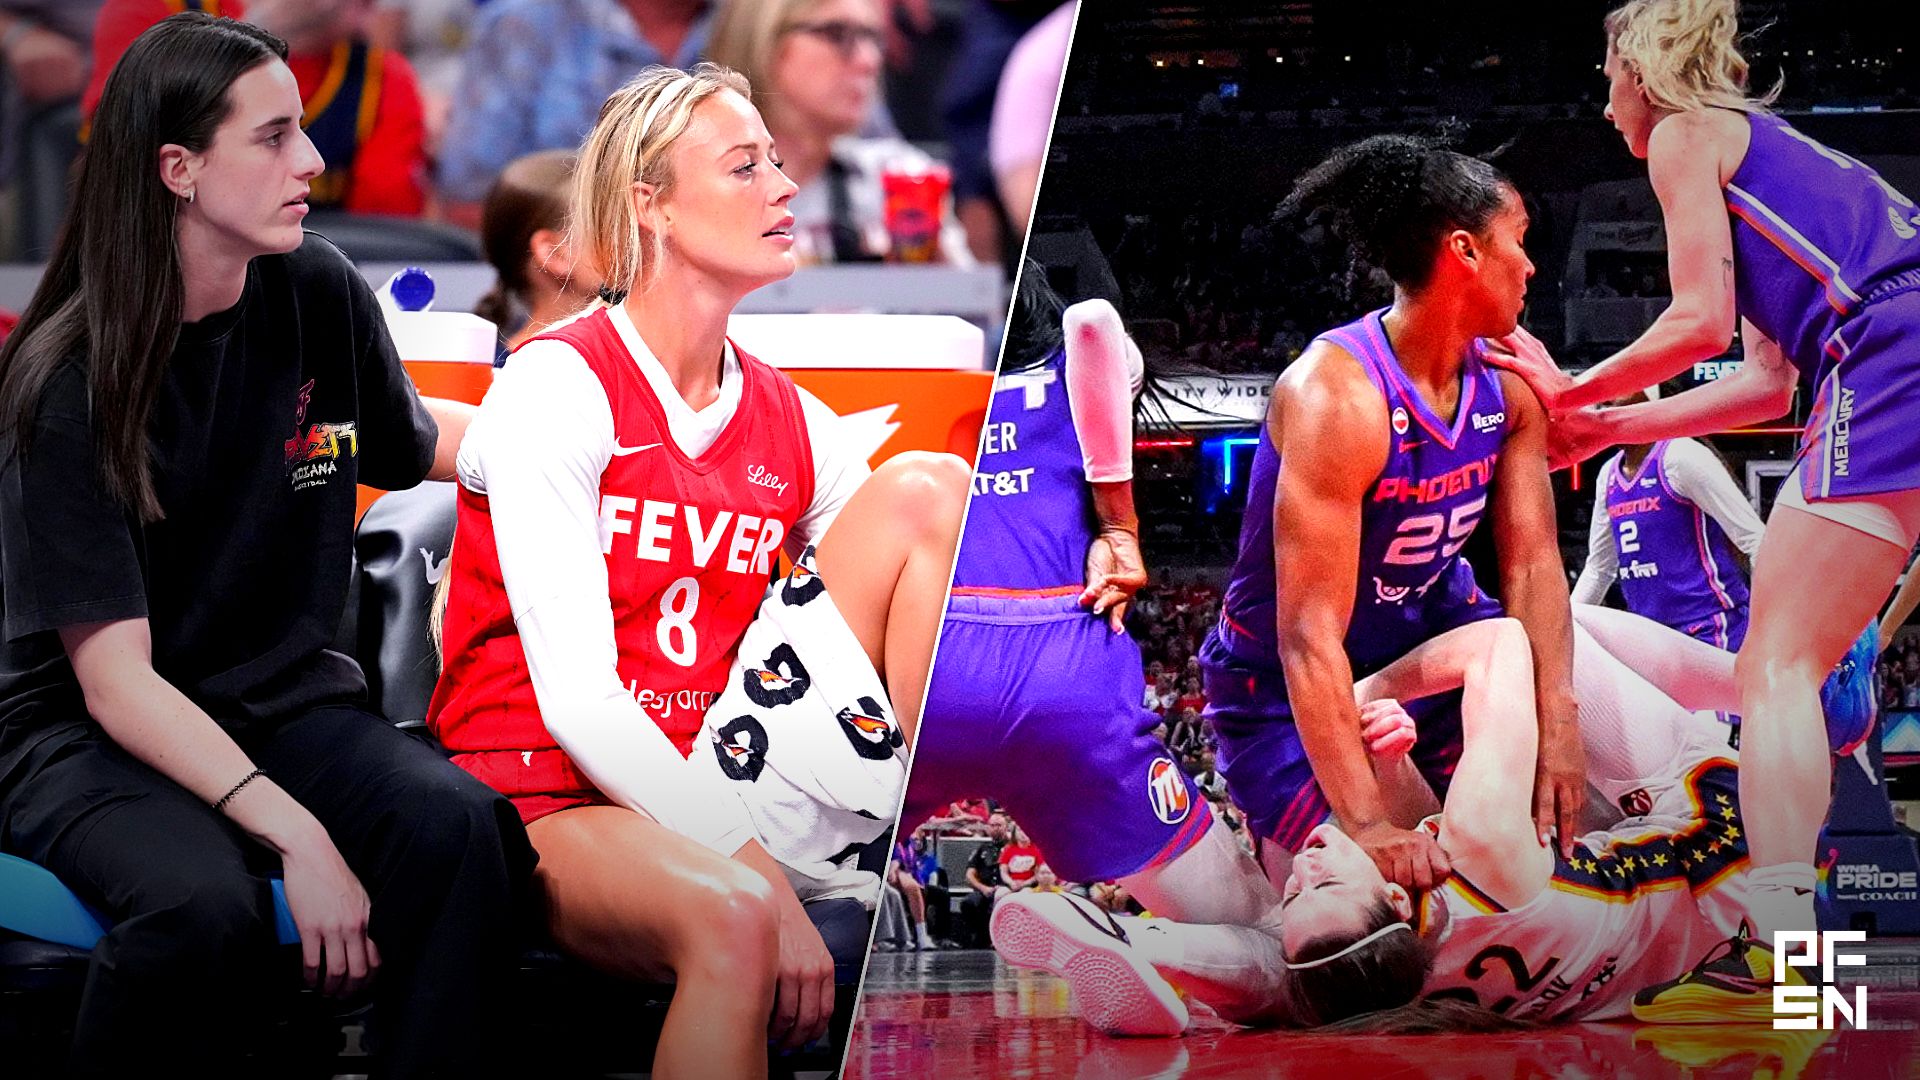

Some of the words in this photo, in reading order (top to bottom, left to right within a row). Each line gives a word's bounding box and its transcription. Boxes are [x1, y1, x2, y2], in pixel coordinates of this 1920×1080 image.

[1160, 388, 1206, 399] ITY
[1834, 387, 1855, 476] MERCURY
[747, 464, 789, 497] Lilly
[1374, 453, 1498, 504] PHOENI
[600, 494, 784, 576] FEVER
[1383, 494, 1487, 566] 25
[1619, 520, 1640, 553] 2
[656, 576, 700, 667] 8
[1836, 864, 1880, 873] WNBA
[1836, 872, 1917, 889] PRIDE
[1859, 892, 1917, 901] COACH
